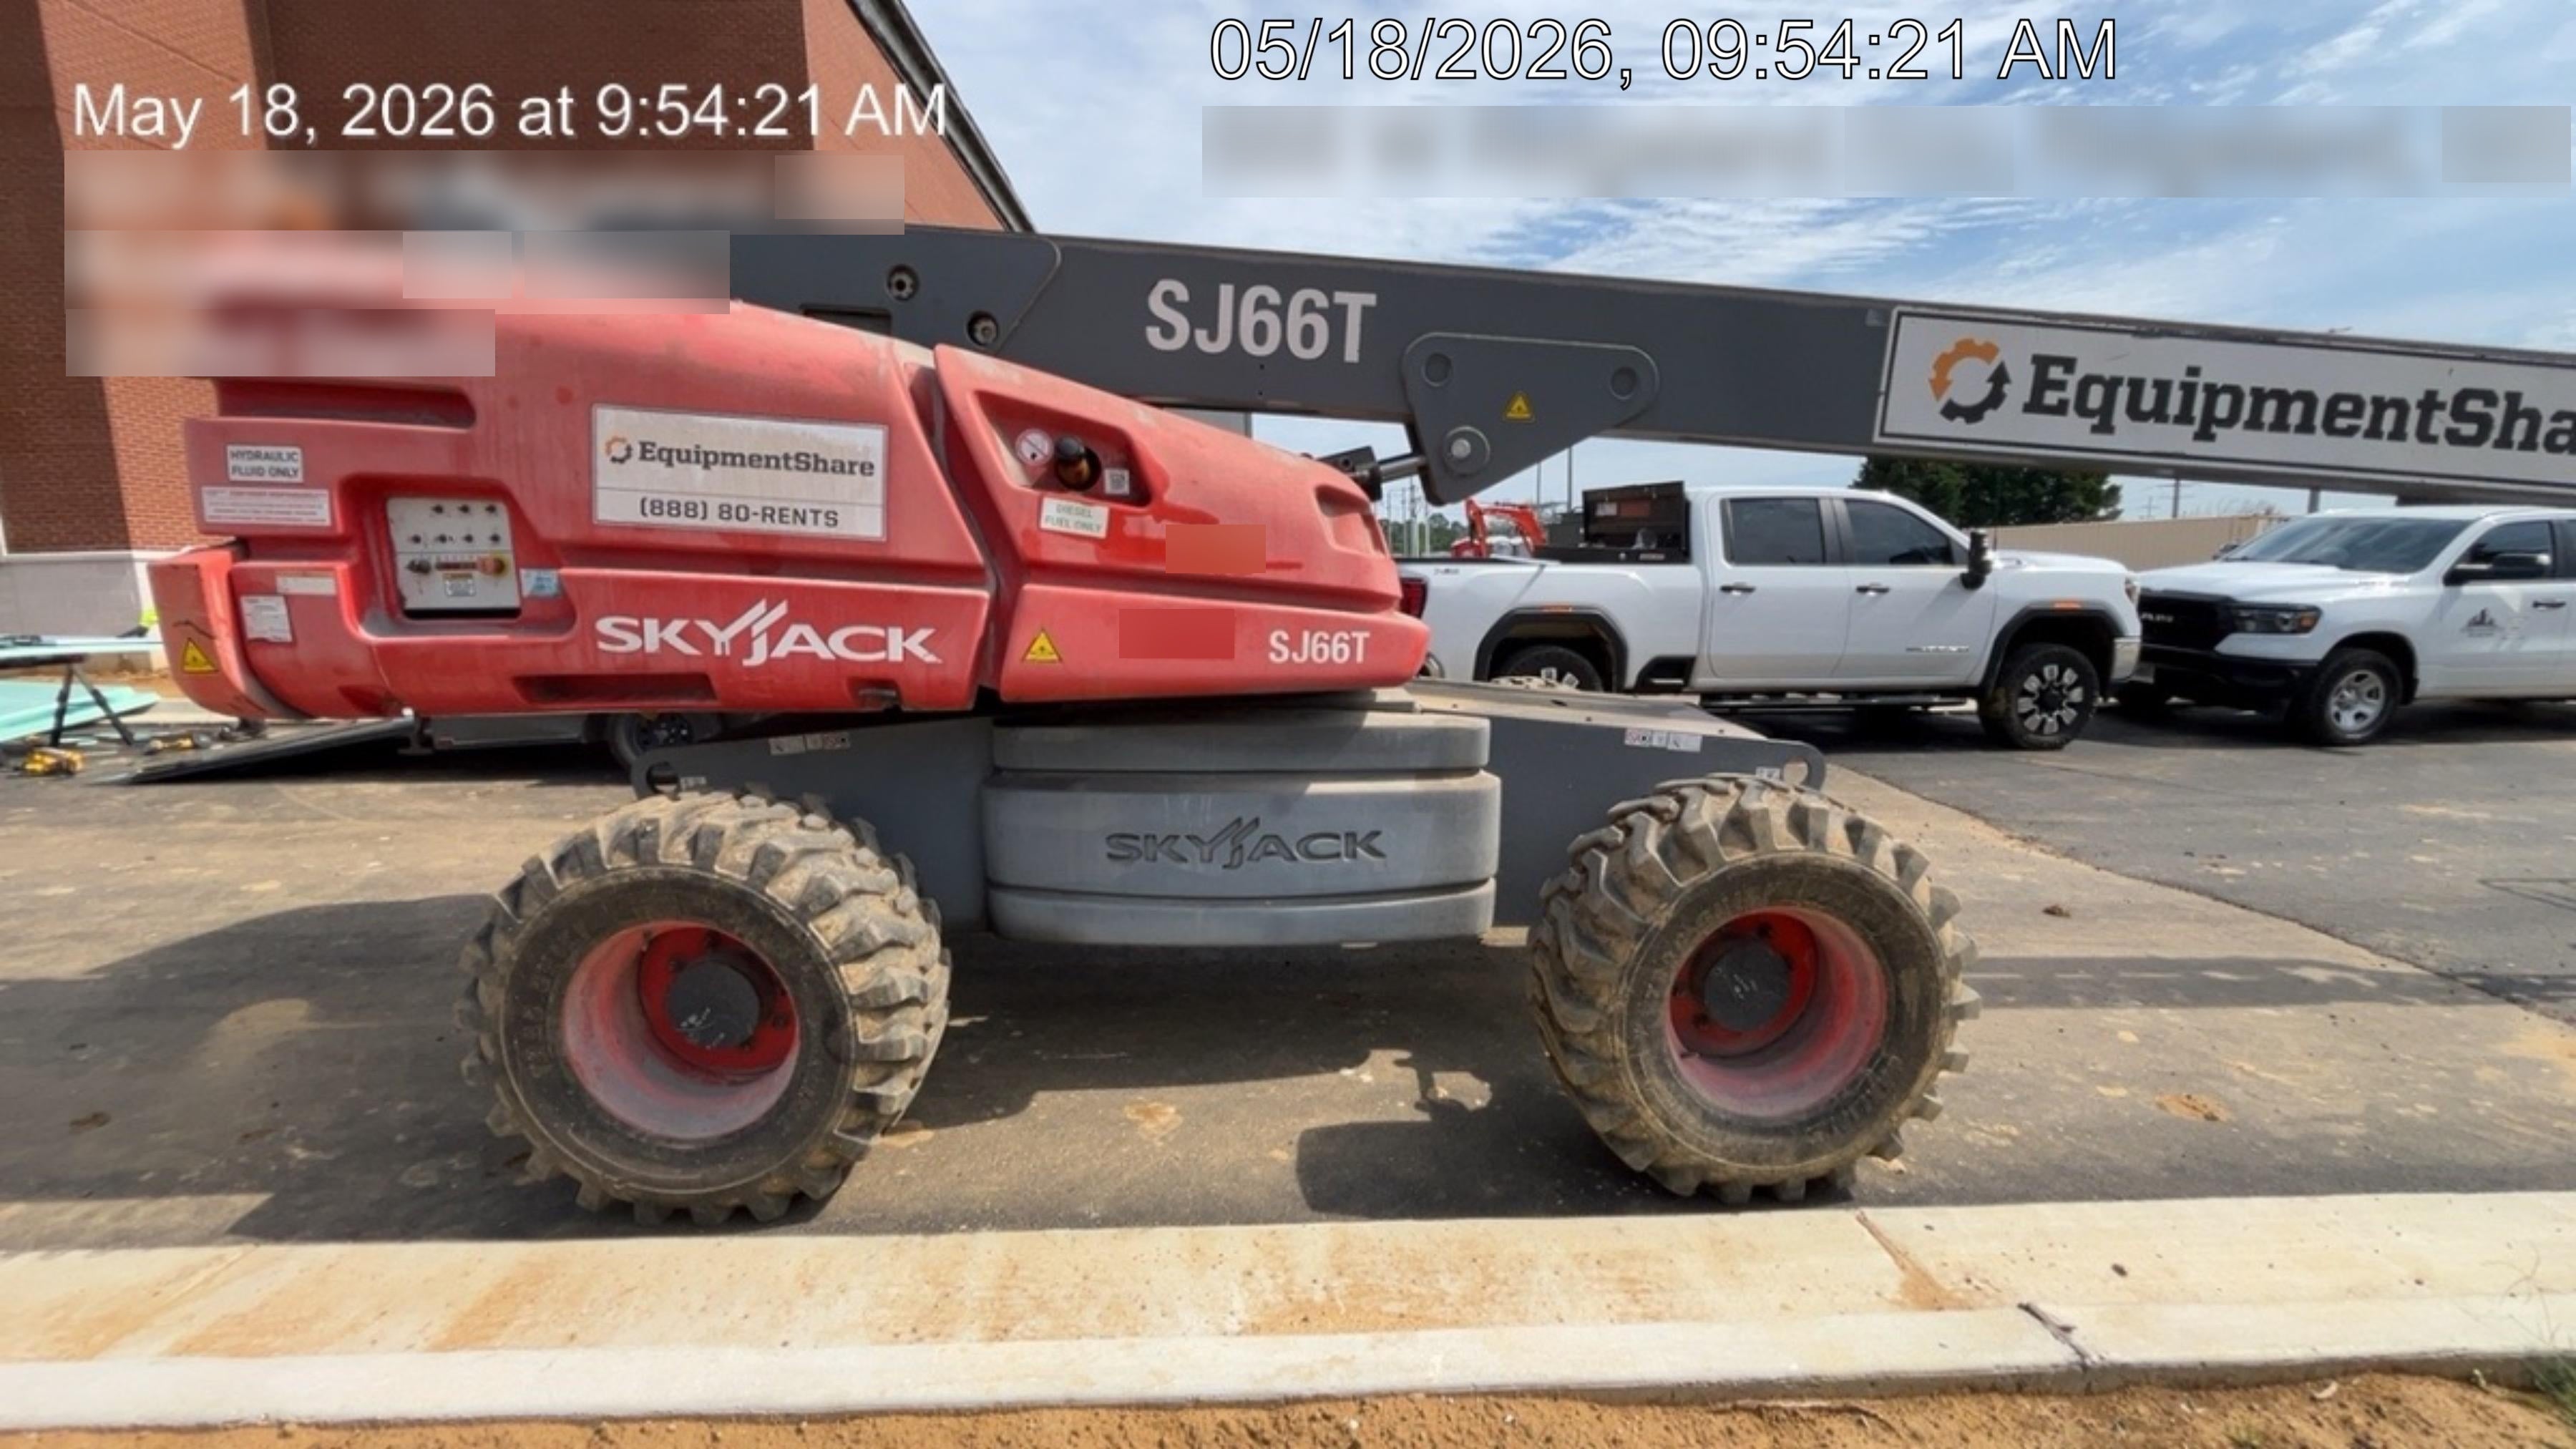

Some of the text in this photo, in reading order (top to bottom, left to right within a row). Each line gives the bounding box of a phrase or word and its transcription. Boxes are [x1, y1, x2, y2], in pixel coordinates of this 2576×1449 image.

[1145, 278, 1377, 364] SJ66T
[2022, 353, 2576, 456] EquipmentSha
[230, 449, 299, 463] HYDRAULIC
[231, 465, 299, 478] FLUID ONLY
[639, 441, 875, 477] EquipmentShare
[640, 497, 839, 528] (888) 80-RENTS
[595, 597, 942, 667] SKYJACK
[1268, 630, 1371, 665] SJ66T
[1104, 815, 1387, 870] SKYJACK
